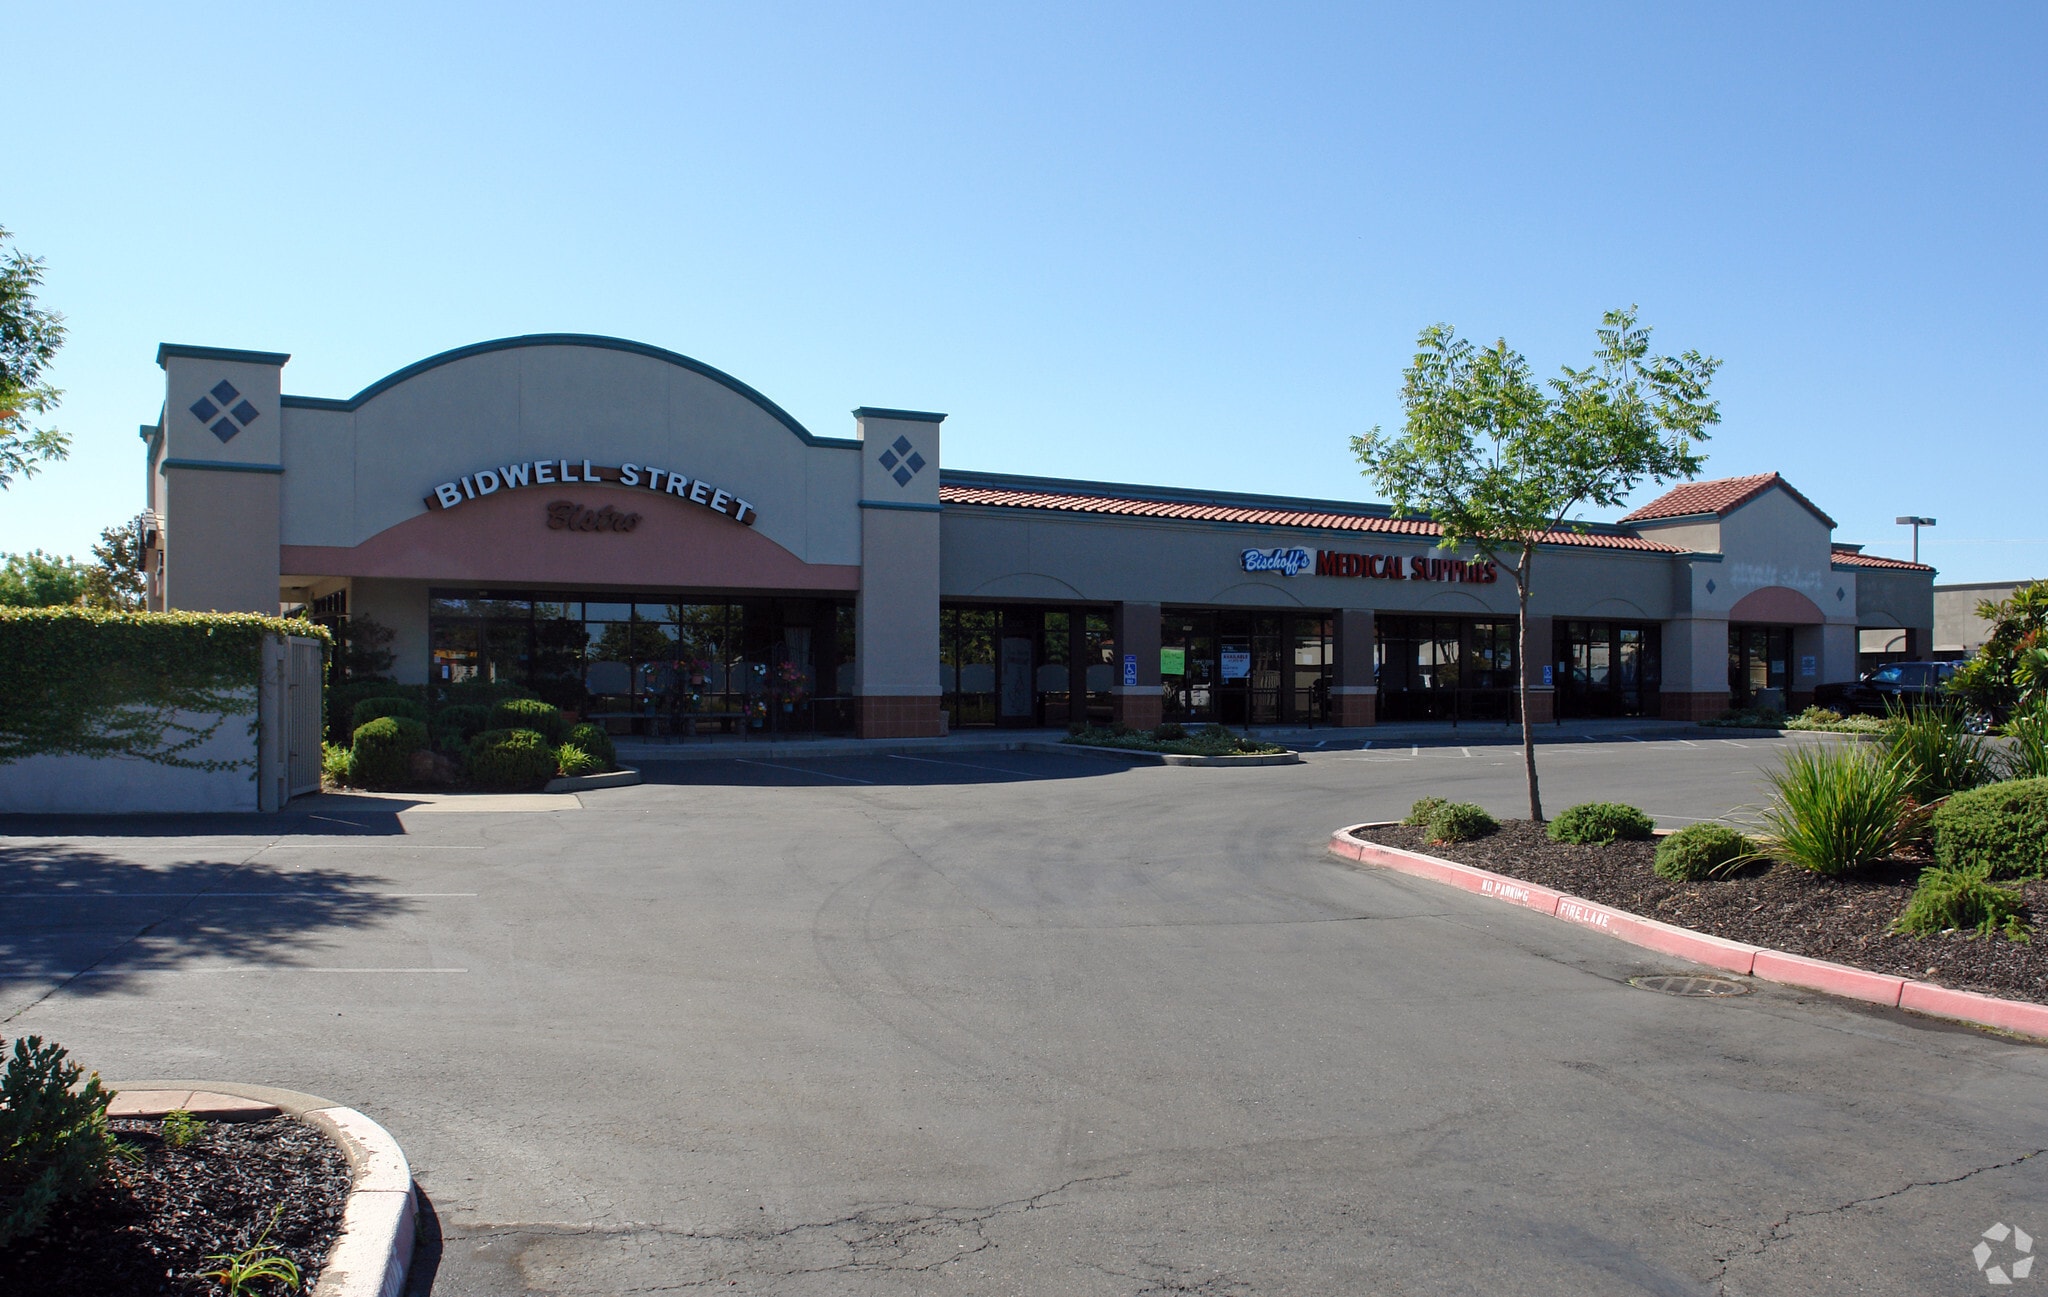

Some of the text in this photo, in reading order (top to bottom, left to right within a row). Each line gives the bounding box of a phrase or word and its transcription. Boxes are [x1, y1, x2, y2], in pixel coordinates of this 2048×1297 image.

[434, 459, 754, 522] BIDWELL STREET
[547, 500, 642, 532] Bistro
[1243, 549, 1497, 583] Bischoff's MEDICAL SUPPLIES
[1481, 879, 1529, 902] NO PARKING
[1560, 902, 1610, 927] FIRE LANE
